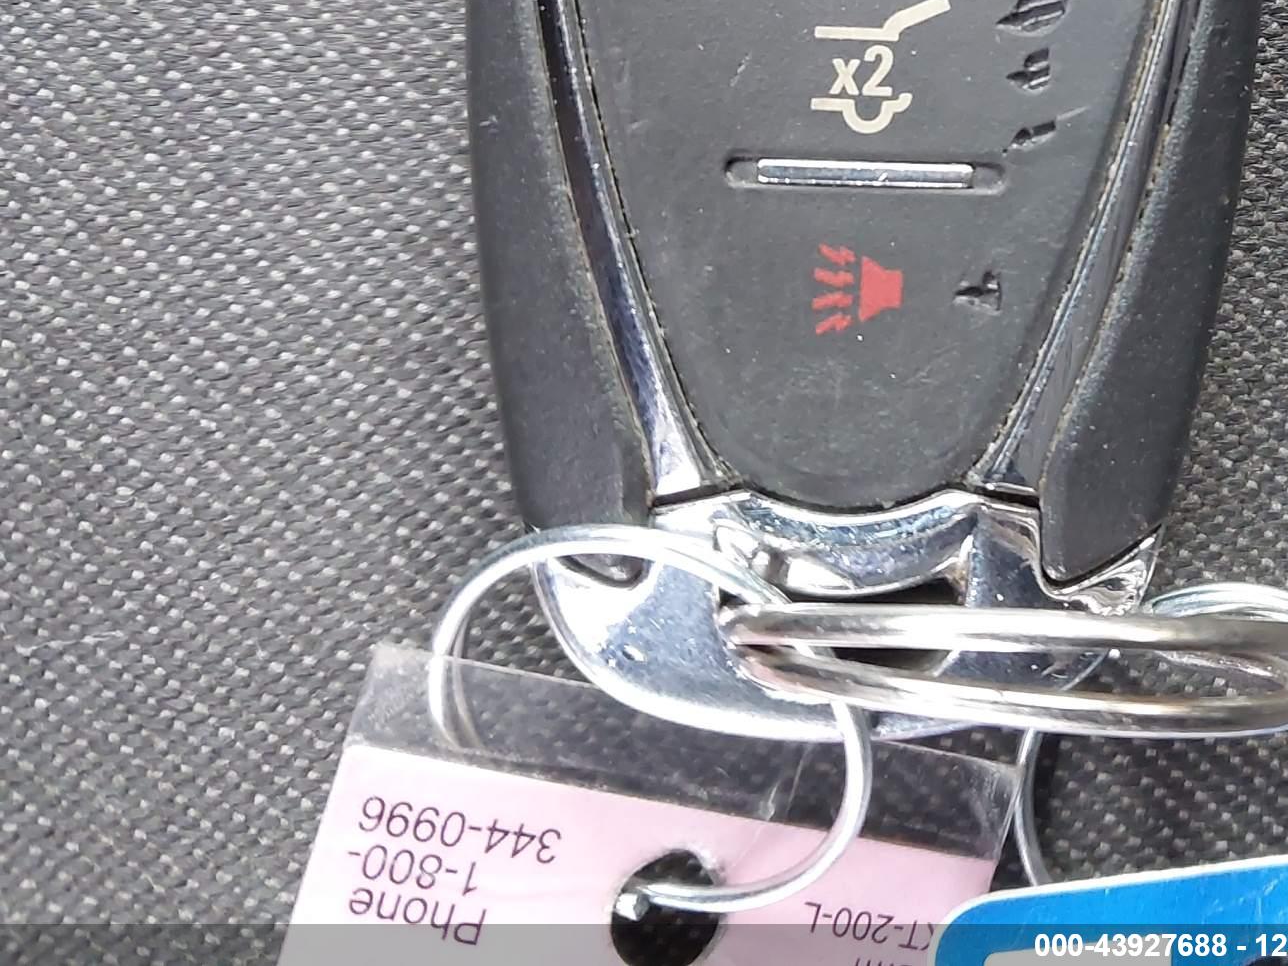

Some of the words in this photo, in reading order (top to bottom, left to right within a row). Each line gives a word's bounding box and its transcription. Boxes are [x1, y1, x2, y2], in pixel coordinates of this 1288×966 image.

[829, 44, 895, 97] x2
[358, 795, 562, 864] 344-0996
[347, 844, 478, 896] 1-800-
[349, 887, 488, 946] Phone
